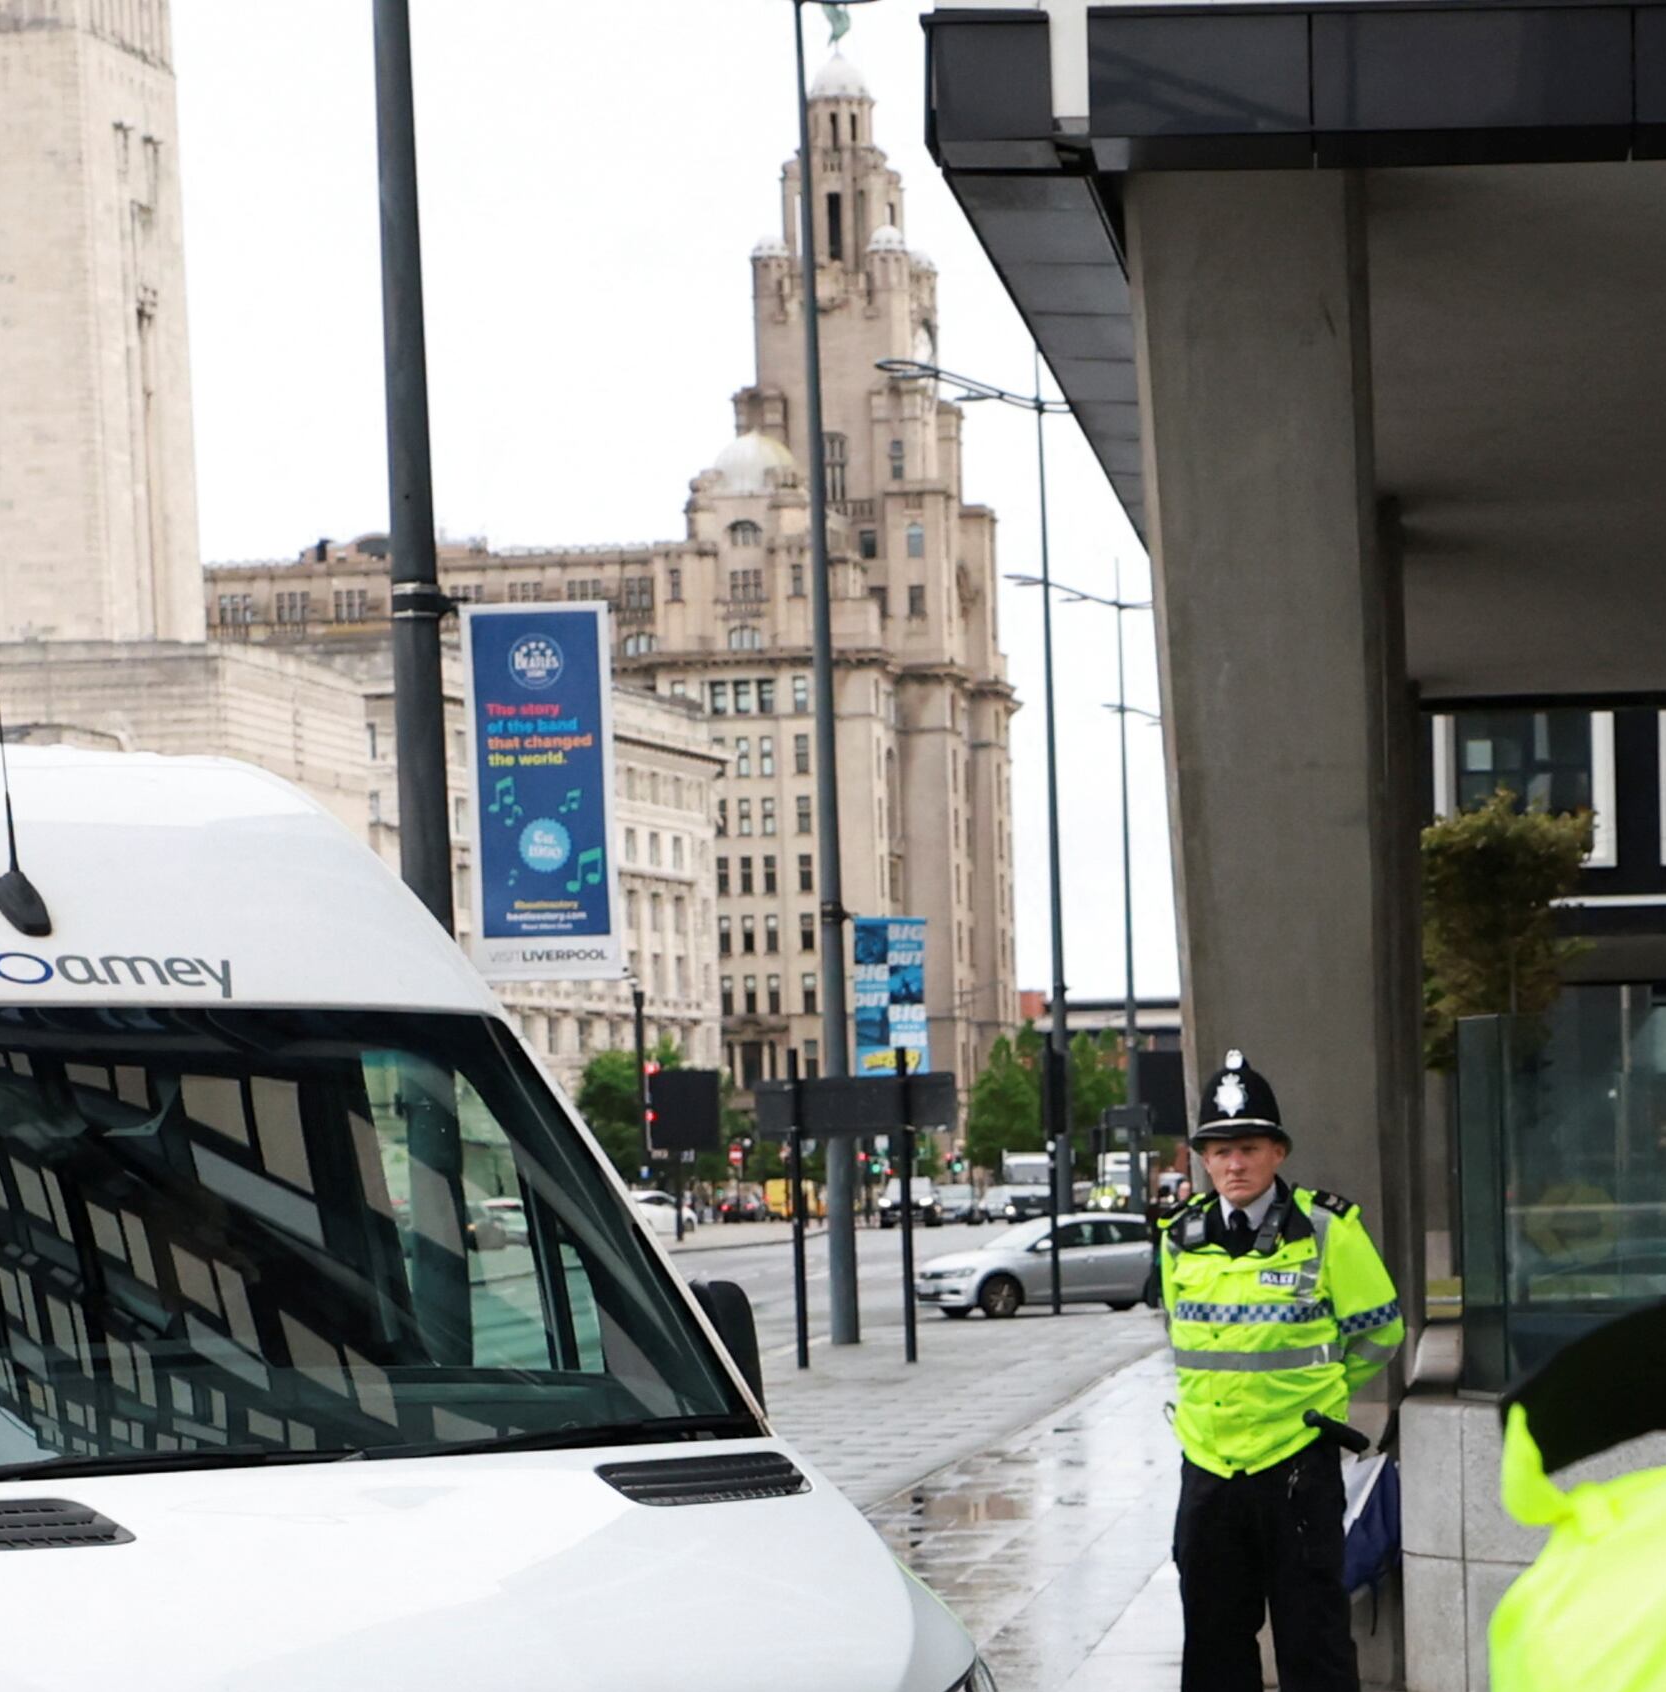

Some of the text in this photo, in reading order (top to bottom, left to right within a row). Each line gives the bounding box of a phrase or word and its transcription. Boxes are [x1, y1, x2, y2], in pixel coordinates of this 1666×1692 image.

[486, 703, 561, 718] The story
[487, 717, 578, 734] of the band
[488, 733, 593, 751] that changed
[488, 751, 568, 767] the world.
[888, 924, 923, 940] BIG
[522, 948, 608, 962] LIVERPOOL
[888, 950, 924, 966] OUT
[888, 1004, 926, 1022] BIG
